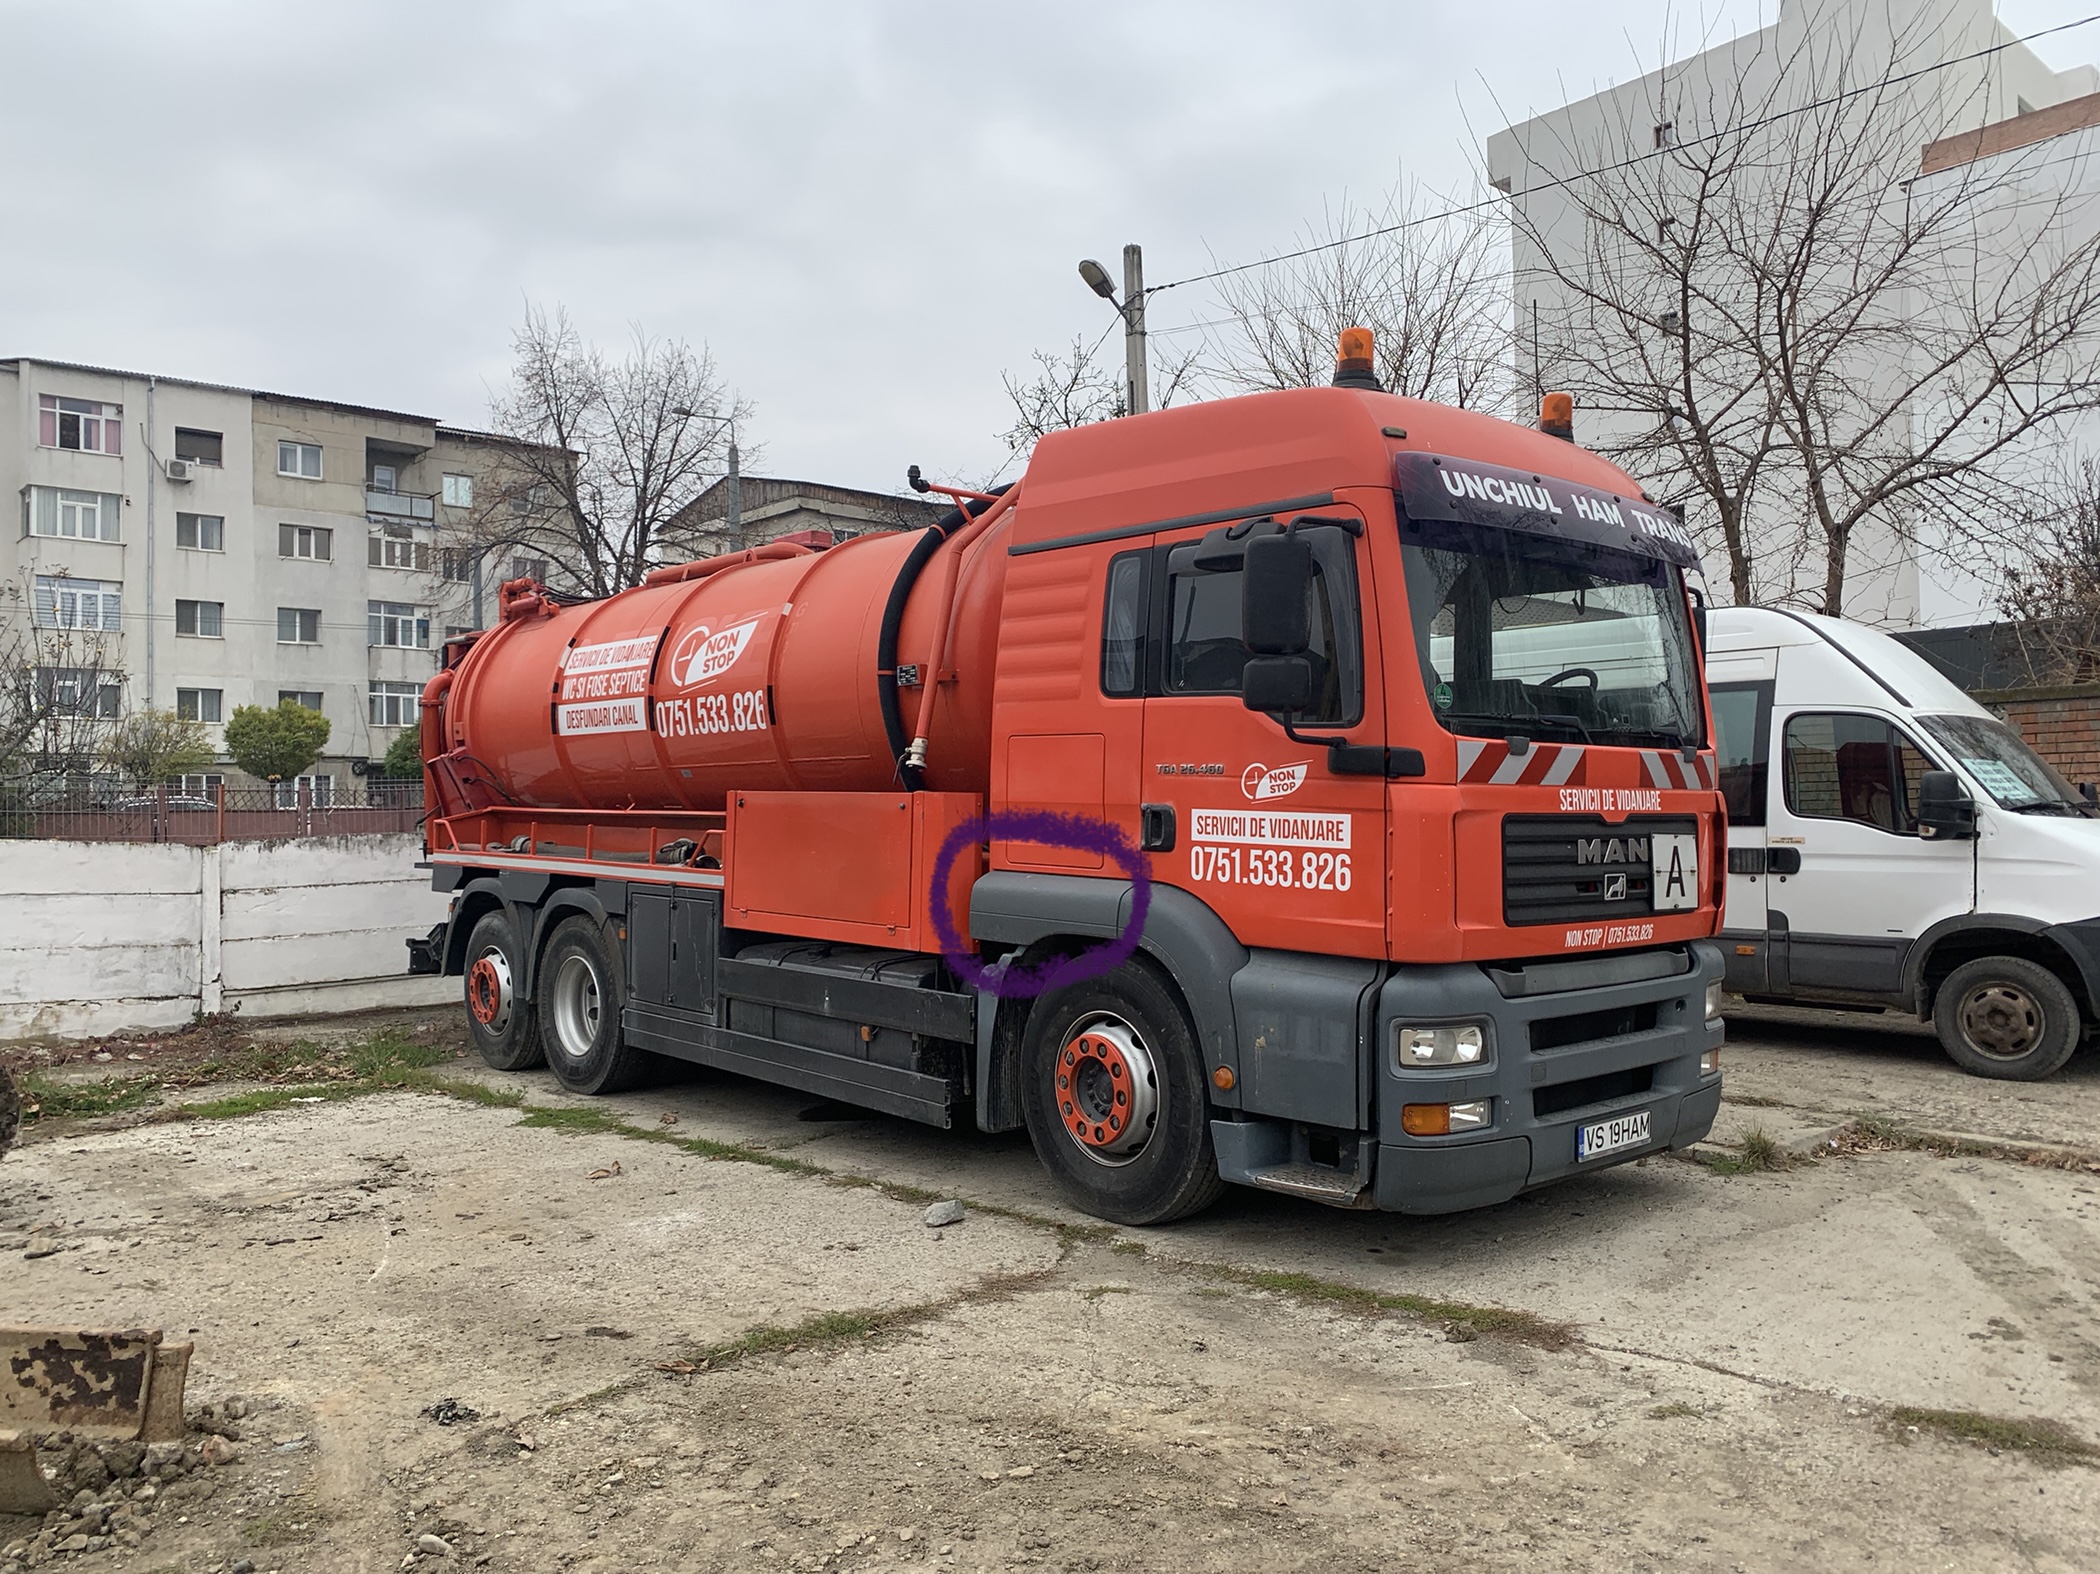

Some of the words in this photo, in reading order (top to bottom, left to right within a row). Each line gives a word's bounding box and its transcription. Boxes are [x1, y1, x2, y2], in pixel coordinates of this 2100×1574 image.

[1440, 469, 1563, 515] UNCHIUL
[1570, 494, 1626, 528] HAM
[1631, 509, 1693, 549] TRANS
[569, 649, 601, 669] SERVICII
[599, 647, 613, 665] DE
[610, 641, 656, 664] VIDANJARE
[705, 630, 741, 656] NON
[702, 650, 735, 674] STOP
[562, 678, 576, 700] WC
[576, 677, 586, 699] SI
[585, 674, 610, 697] FOSE
[609, 669, 648, 695] SEPTICE
[566, 707, 612, 730] DESFUNDARI
[612, 704, 639, 727] CANAL
[655, 690, 767, 739] 0751.533.826
[1155, 763, 1178, 775] TGA
[1268, 769, 1296, 784] NON
[1269, 781, 1296, 794] STOP
[1559, 788, 1600, 811] SERVICII
[1602, 789, 1615, 810] DE
[1615, 790, 1662, 811] VIDANJARE
[1196, 815, 1247, 838] SERVICII
[1250, 818, 1266, 838] DE
[1269, 818, 1345, 842] VIDANJARE
[1577, 838, 1649, 865] MAN
[1190, 846, 1351, 892] 0751.533.826
[1665, 845, 1686, 898] A
[1564, 929, 1582, 948] NON
[1583, 928, 1603, 947] STOP
[1608, 923, 1654, 944] 0751.533.826
[1586, 1126, 1605, 1151] VS
[1609, 1113, 1650, 1145] 19HAM
